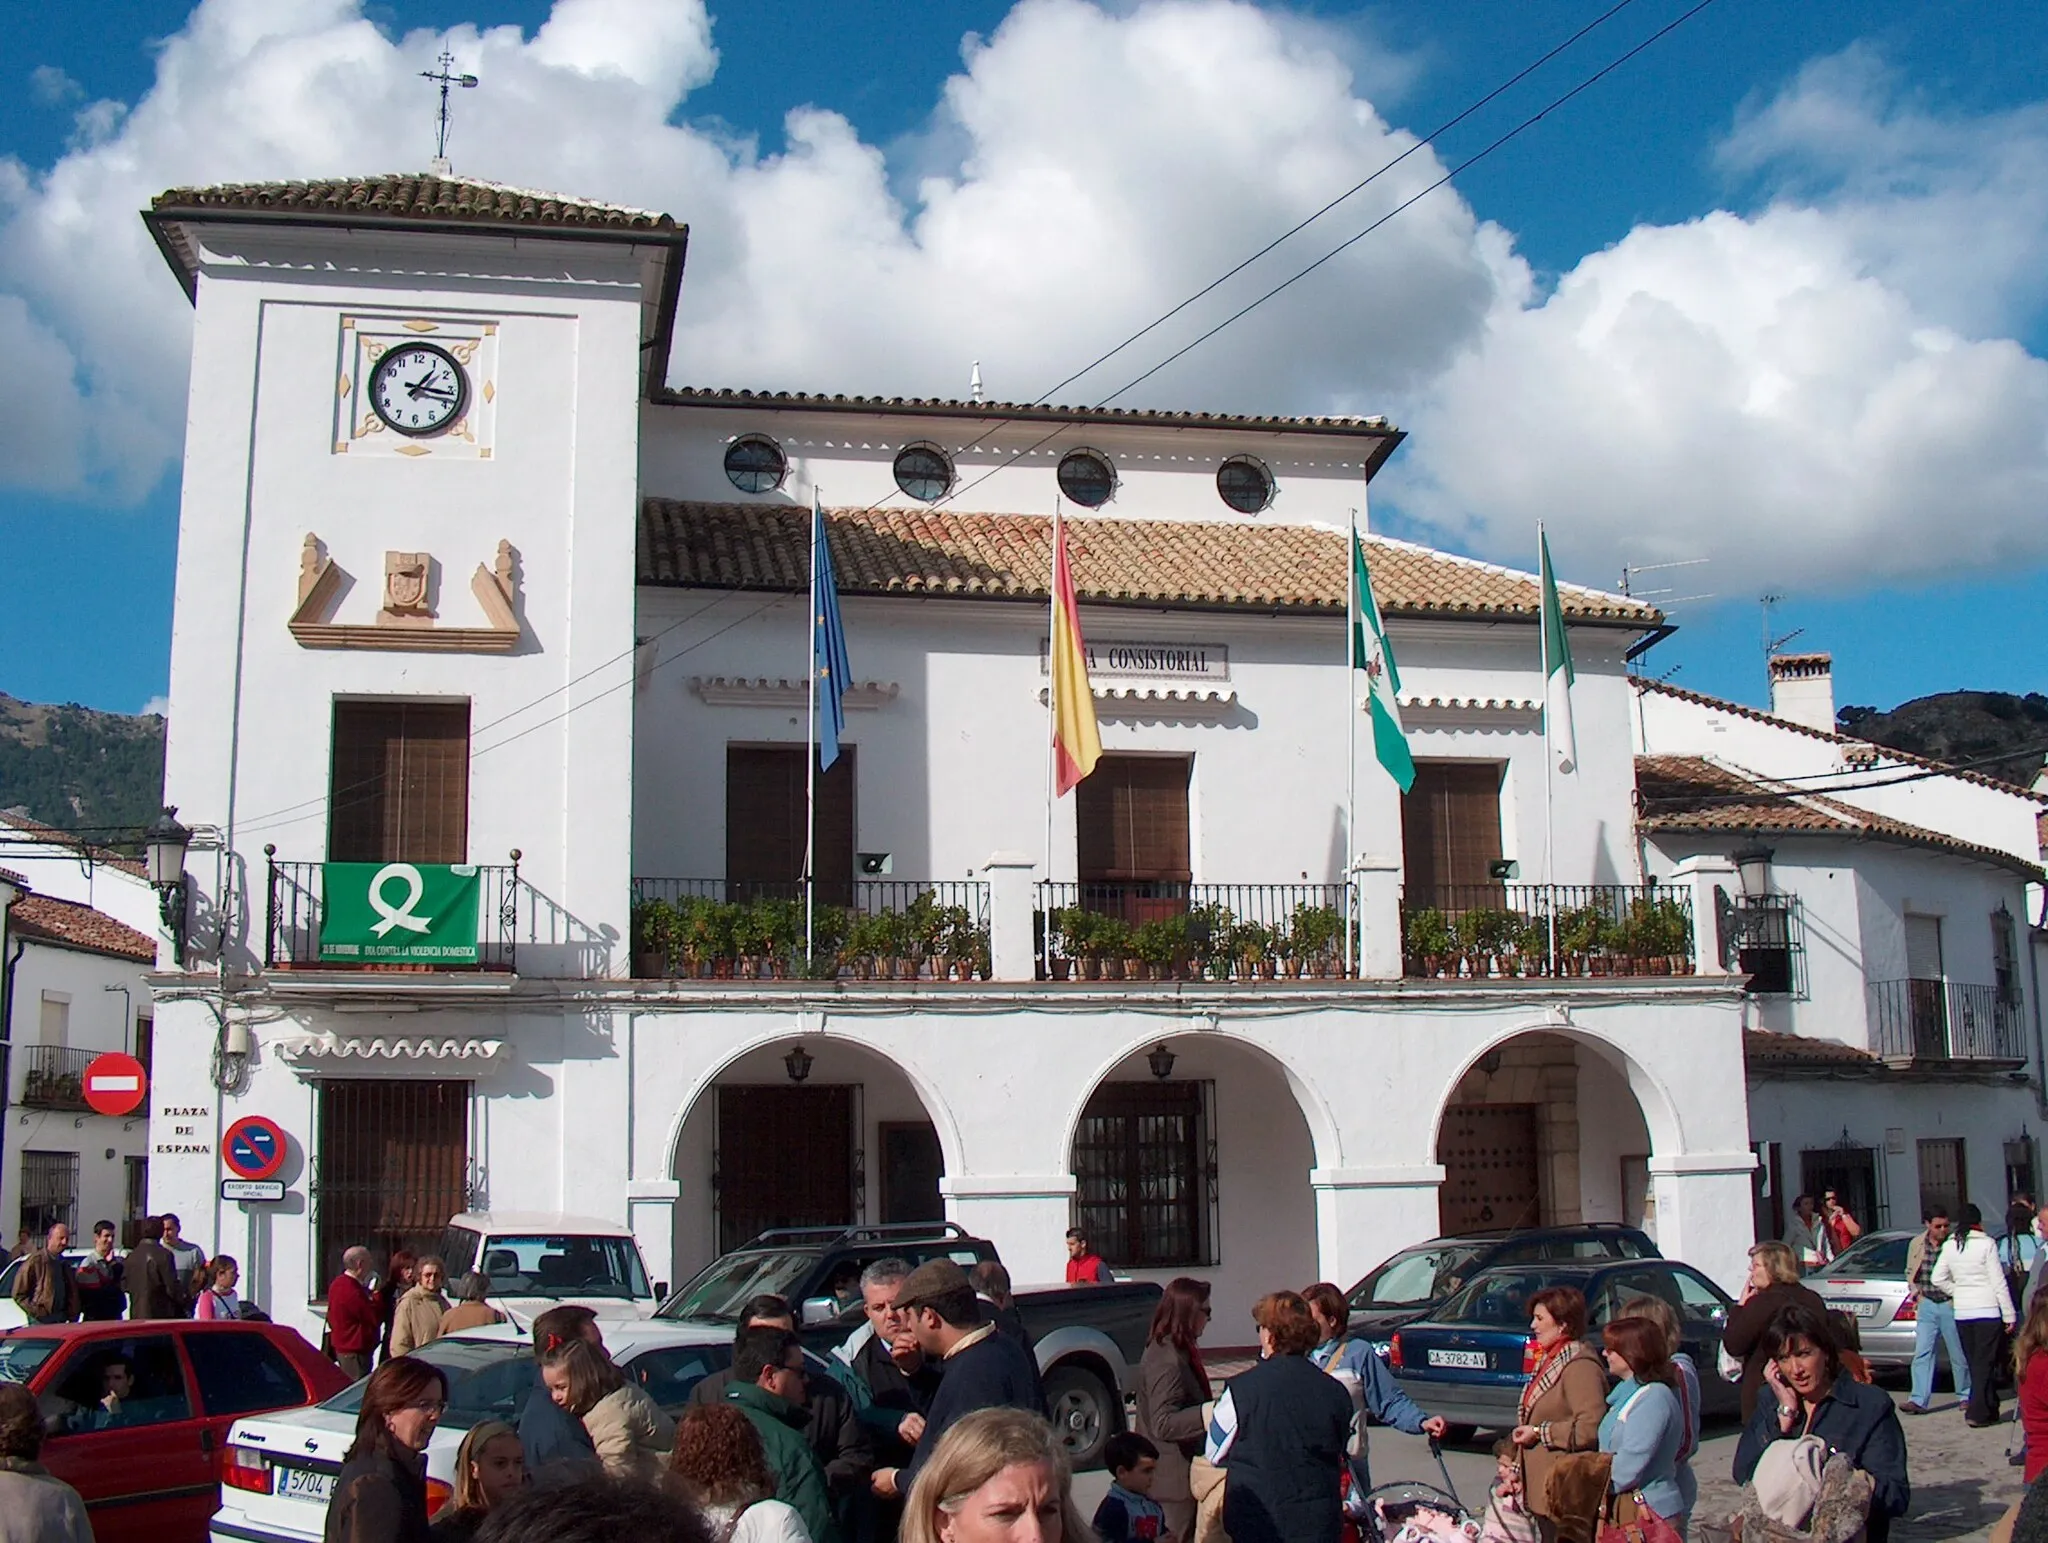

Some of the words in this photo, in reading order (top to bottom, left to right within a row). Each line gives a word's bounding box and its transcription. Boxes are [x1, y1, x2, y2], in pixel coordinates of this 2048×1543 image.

[398, 359, 406, 368] 11
[413, 354, 425, 364] 12
[432, 359, 437, 369] 1
[387, 368, 397, 378] 10
[443, 370, 449, 380] 2
[380, 383, 387, 392] 9
[447, 385, 454, 395] 3
[384, 398, 390, 407] 8
[441, 400, 447, 409] 4
[396, 409, 402, 419] 7
[412, 414, 418, 423] 6
[428, 411, 435, 420] 5
[1109, 648, 1209, 672] CONSISTORIAL
[164, 1107, 209, 1116] PLAZA
[175, 1126, 194, 1136] DE
[1429, 1351, 1485, 1366] CA-3782-AV
[291, 1470, 323, 1494] 5704
